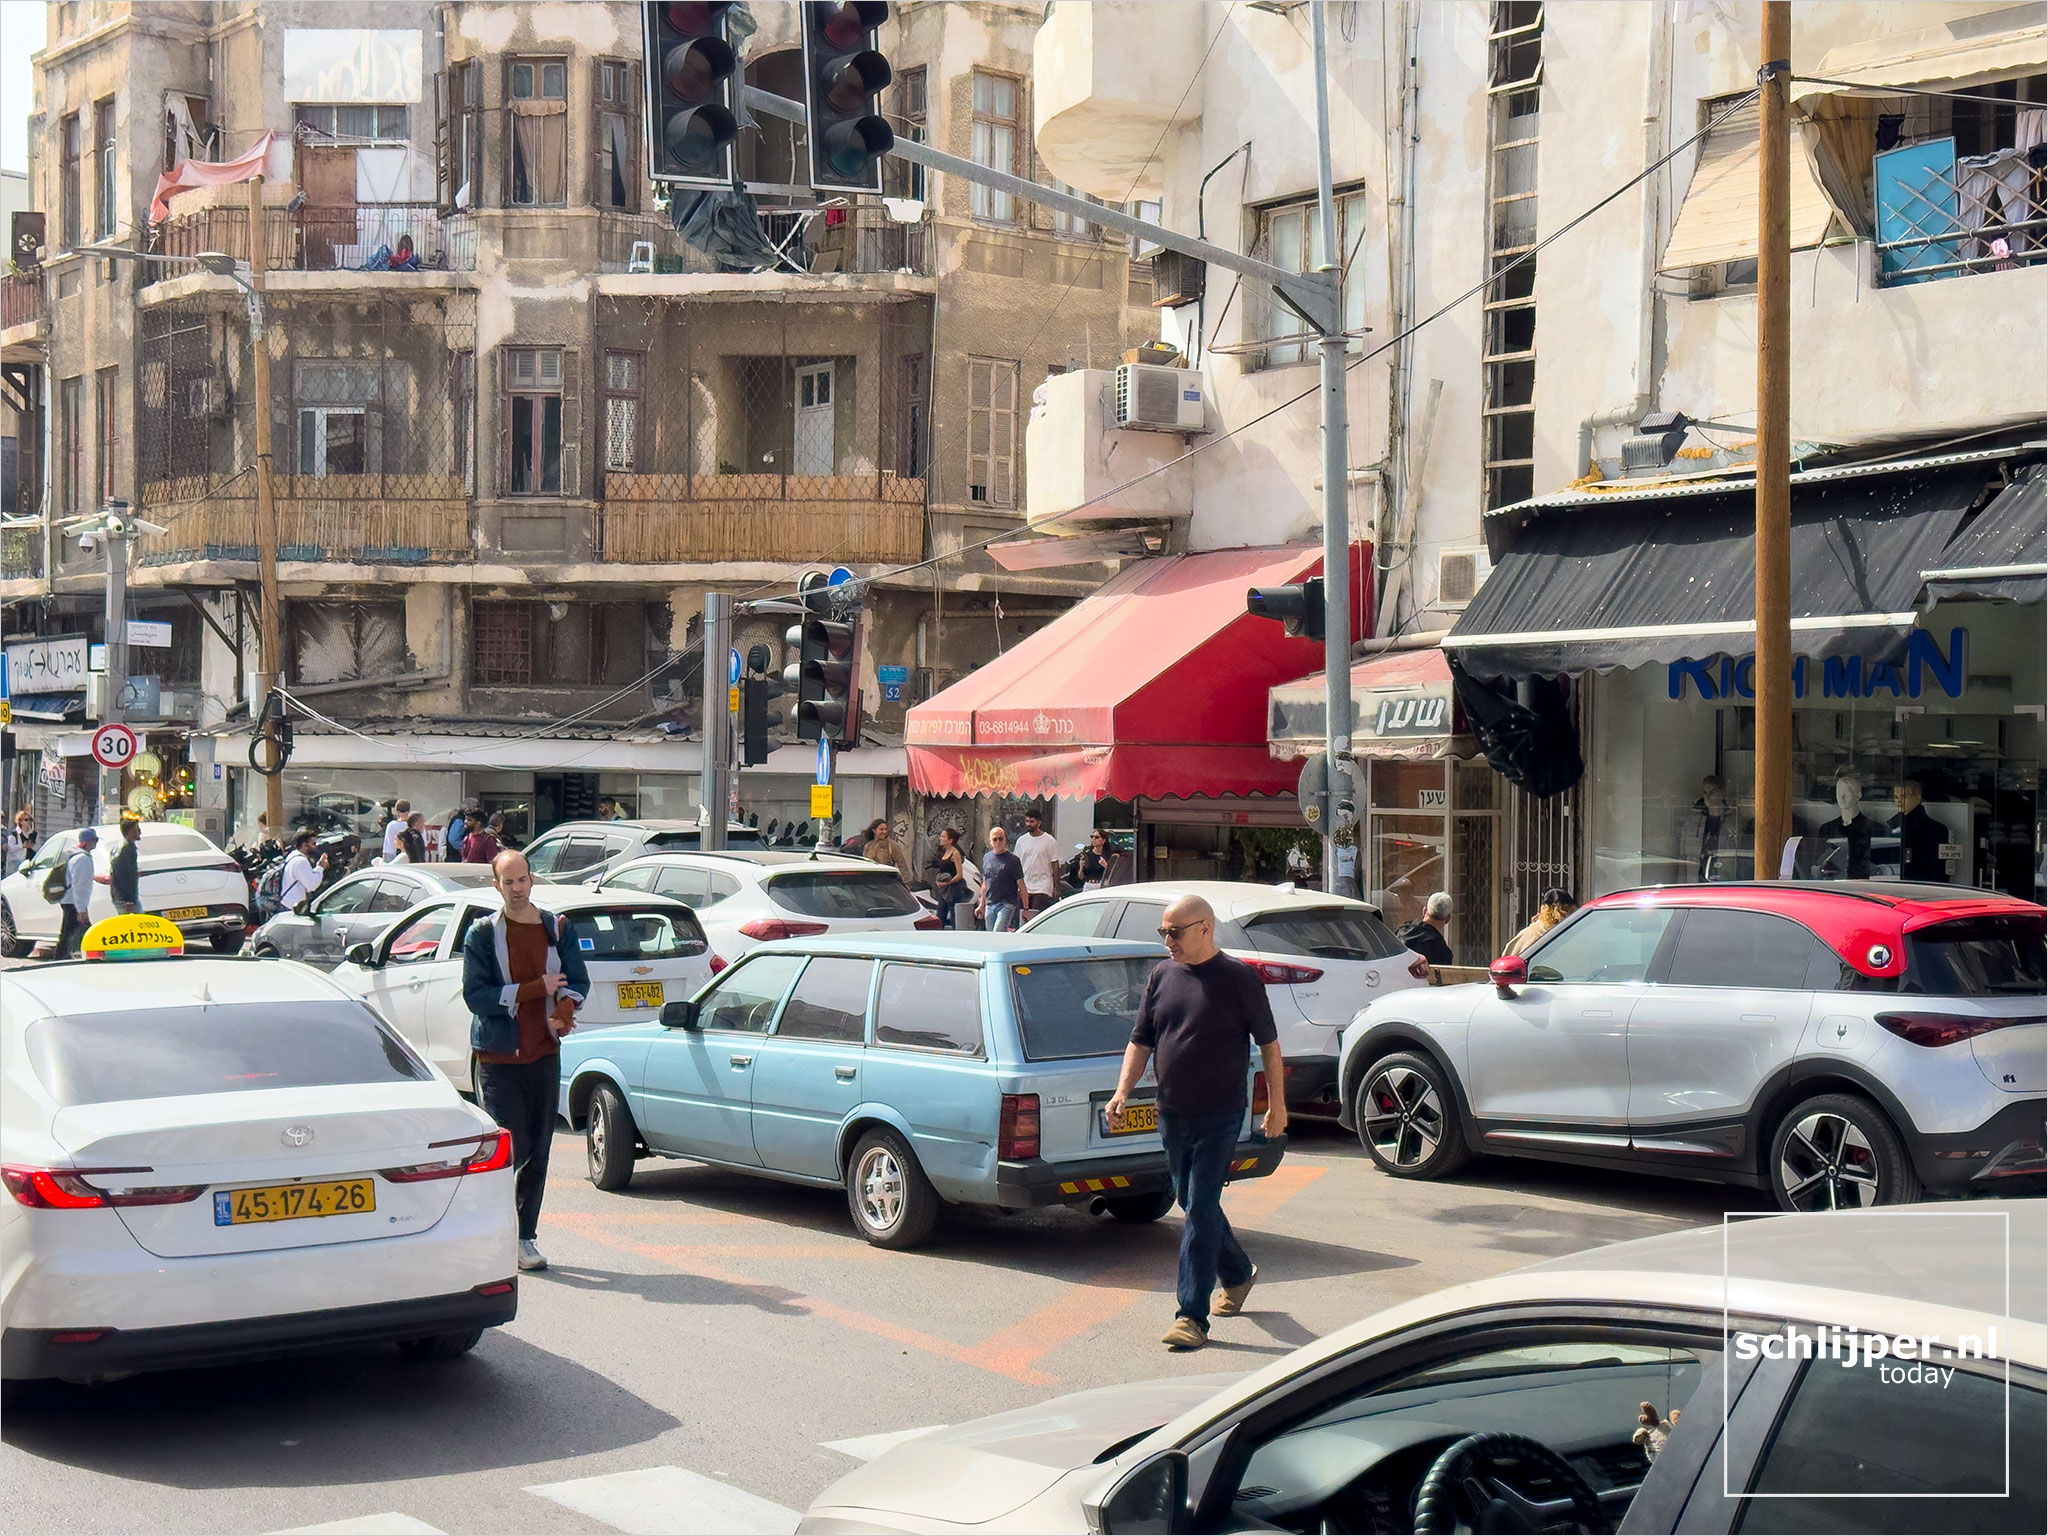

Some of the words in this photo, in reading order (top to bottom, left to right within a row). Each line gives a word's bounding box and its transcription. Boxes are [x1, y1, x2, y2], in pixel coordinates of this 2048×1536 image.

[1823, 627, 1965, 699] MAN
[888, 687, 900, 698] 52
[1376, 698, 1445, 736] שען
[944, 719, 971, 734] המרכז
[979, 720, 1029, 734] 03-6814944
[1051, 719, 1074, 734] כתר
[101, 737, 129, 756] 30
[1420, 790, 1446, 807] שען
[101, 930, 135, 946] taxi
[137, 931, 174, 944] מונית
